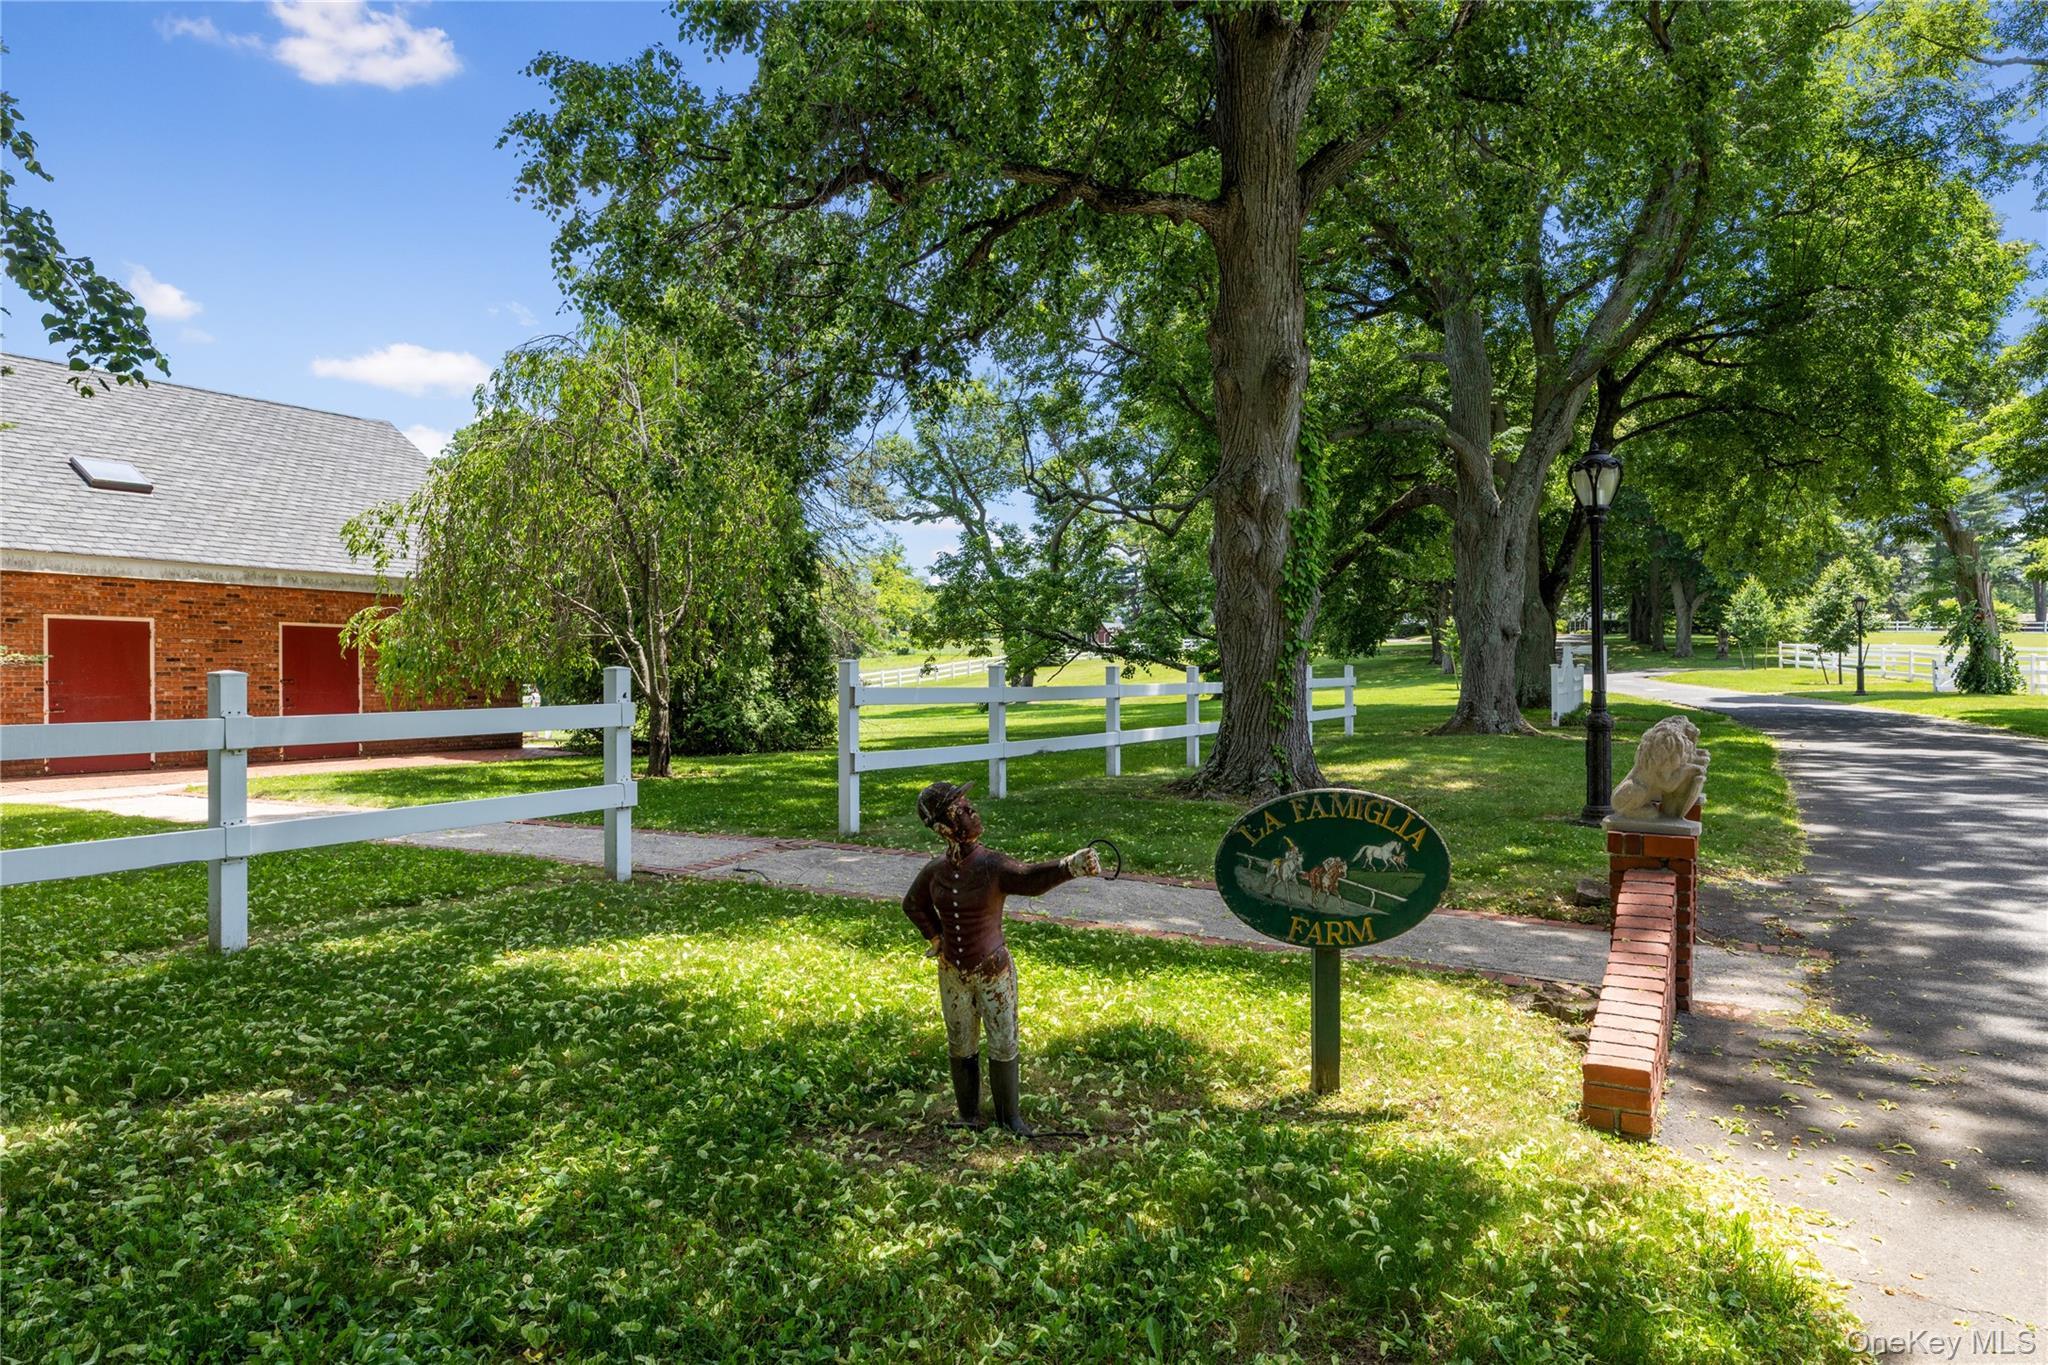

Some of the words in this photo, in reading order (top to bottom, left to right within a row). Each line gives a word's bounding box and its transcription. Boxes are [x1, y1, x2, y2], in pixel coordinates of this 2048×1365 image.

[1237, 810, 1286, 847] LA
[1289, 793, 1429, 851] FAMIGLIA
[1286, 916, 1377, 946] FARM
